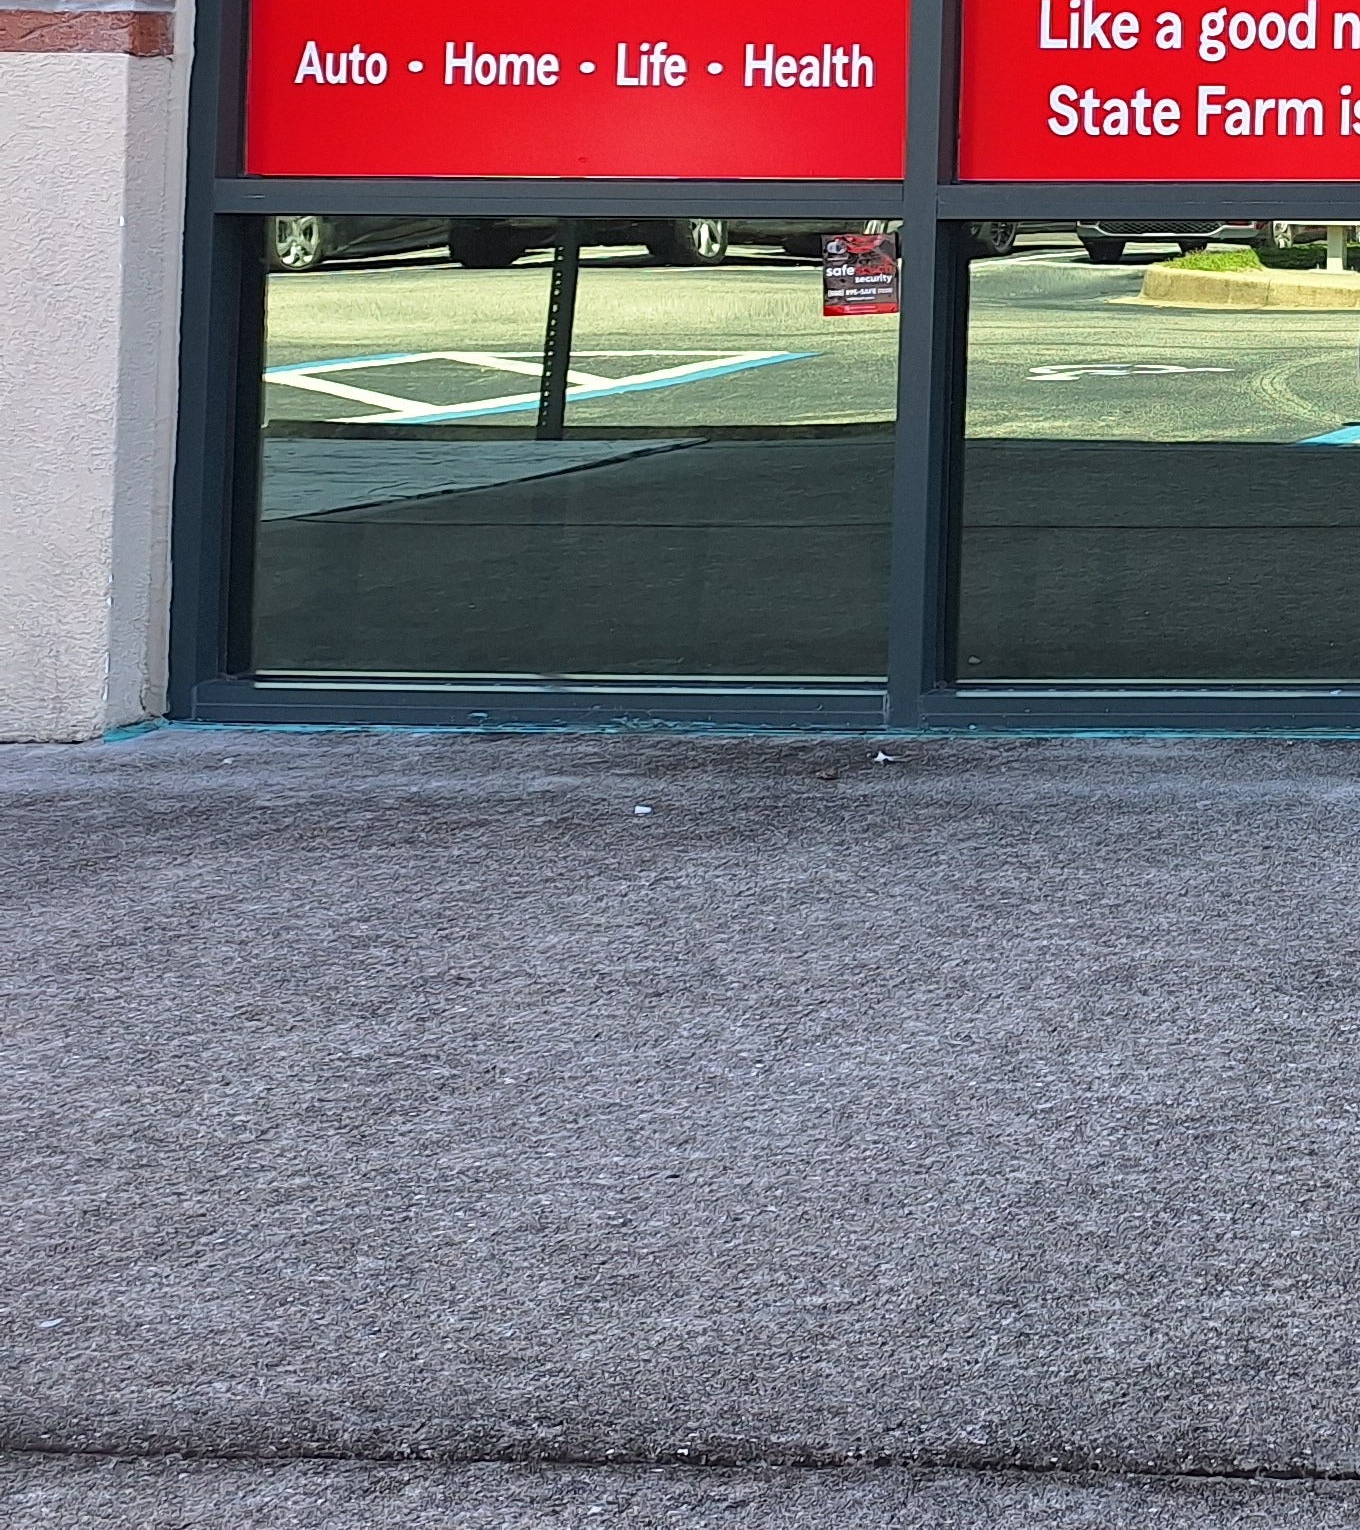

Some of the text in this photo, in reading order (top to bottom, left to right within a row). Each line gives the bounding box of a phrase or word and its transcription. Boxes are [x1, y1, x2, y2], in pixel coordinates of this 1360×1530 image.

[1156, 12, 1181, 49] a
[1199, 0, 1316, 61] good
[295, 41, 873, 87] Auto Home Life Health
[1048, 85, 1180, 135] State
[1198, 86, 1323, 135] Farm
[855, 273, 892, 284] security
